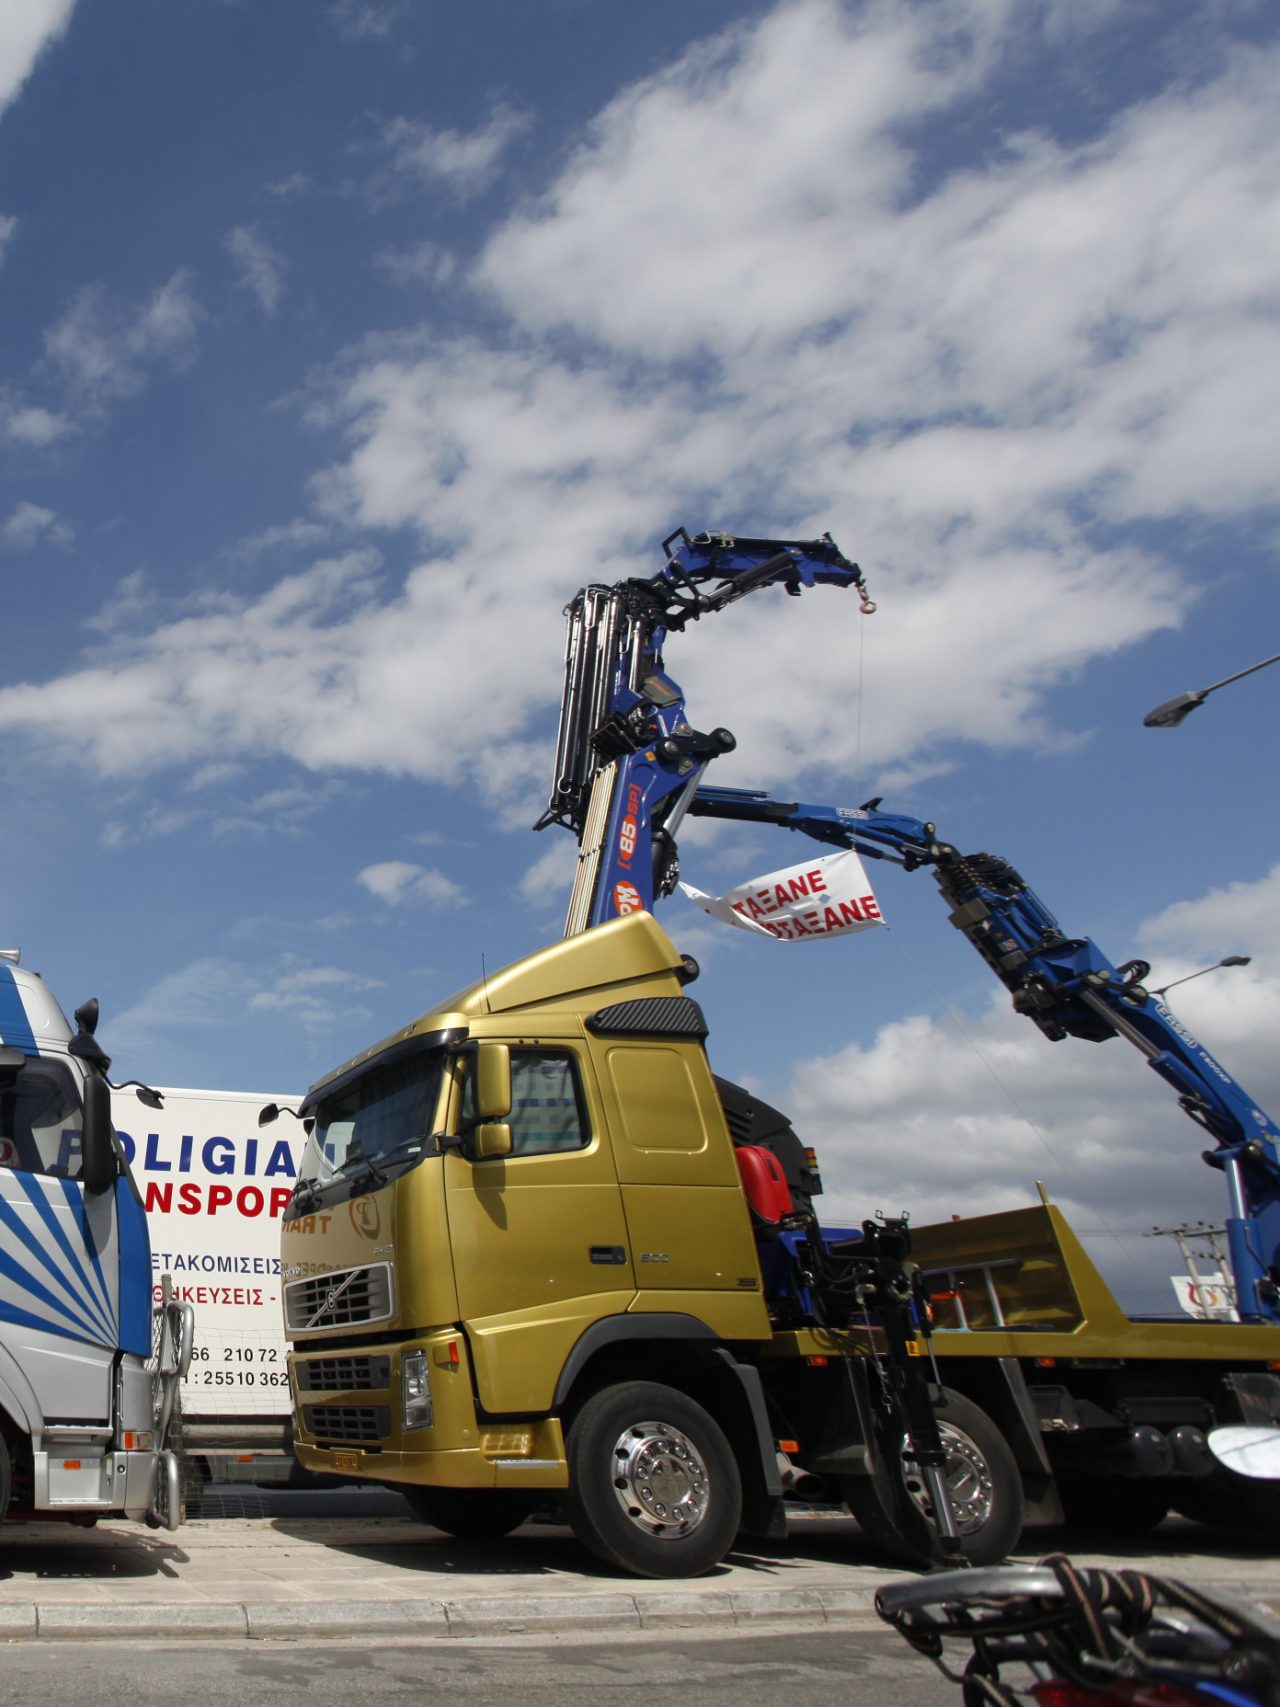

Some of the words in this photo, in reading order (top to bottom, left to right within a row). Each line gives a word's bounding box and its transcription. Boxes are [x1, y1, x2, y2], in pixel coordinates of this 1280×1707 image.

[223, 1347, 254, 1362] 210
[258, 1348, 278, 1362] 72
[203, 1371, 255, 1386] 25510
